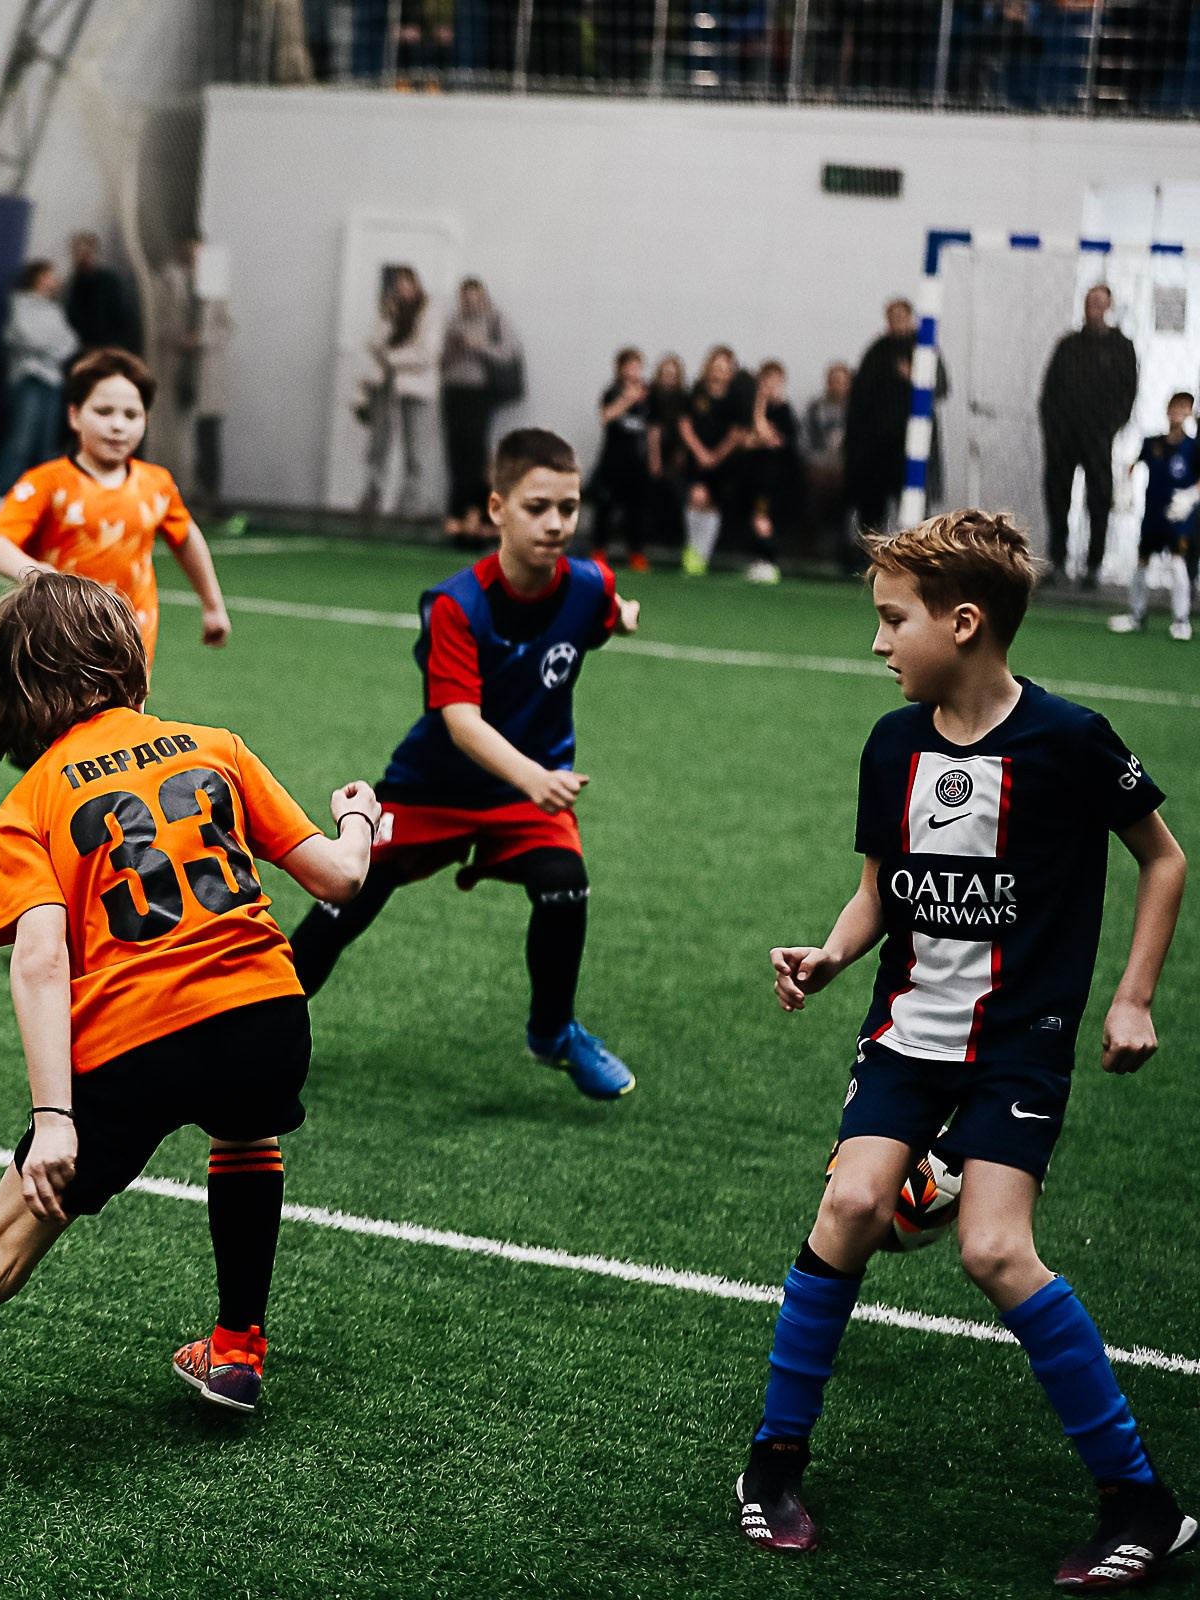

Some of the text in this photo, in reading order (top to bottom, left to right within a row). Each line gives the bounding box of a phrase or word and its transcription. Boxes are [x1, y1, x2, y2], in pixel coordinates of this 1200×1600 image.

[60, 734, 199, 790] ТВЕРДОВ
[70, 768, 262, 942] 33
[891, 869, 1017, 905] QATAR
[914, 904, 1017, 925] AIRWAYS
